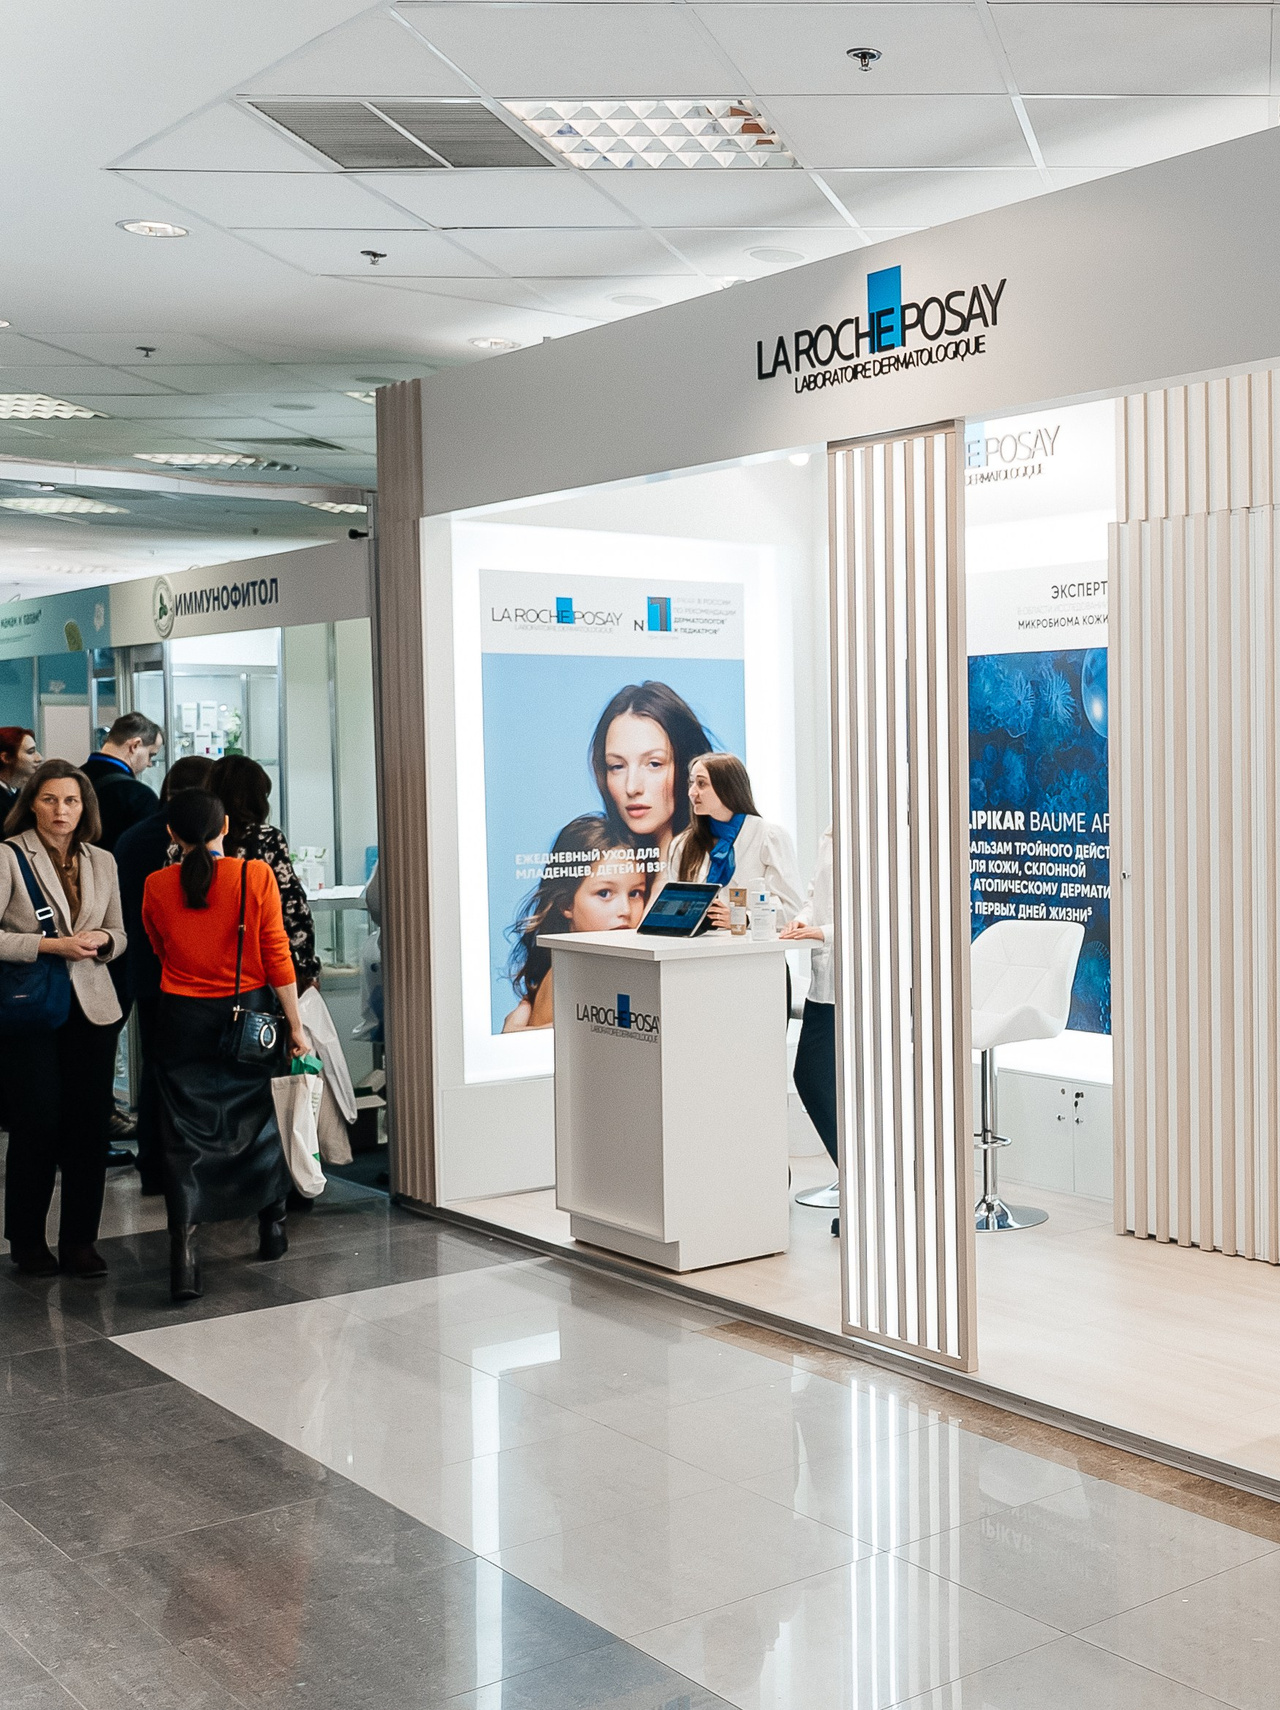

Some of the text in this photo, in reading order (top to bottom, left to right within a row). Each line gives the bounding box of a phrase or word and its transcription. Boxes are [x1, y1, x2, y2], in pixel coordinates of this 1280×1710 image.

[756, 278, 1007, 380] LA ROCHE POSAY
[794, 335, 987, 394] LABORATOIRE DERMATOLOGIQUE
[985, 425, 1060, 467] POSAY
[175, 578, 279, 617] ИММУНОФИТОЛ
[1051, 581, 1108, 599] ЭКСПЕРТ
[491, 607, 622, 626] LA ROCHE POSAY
[1018, 613, 1108, 630] МИКРОБИОМА КОЖИ
[969, 811, 1025, 831] IPIKAR
[1030, 812, 1086, 832] BAUME
[515, 847, 660, 866] ЕЖЕДНЕВНЫЙ УХОД ДЛЯ
[969, 840, 1110, 860] АЛЬЗАМ ТРОЙНОГО ДЕЙСТ
[515, 861, 668, 880] МЛАДЕНЦЕВ, ДЕТЕЙ И ВЗР
[988, 860, 1022, 876] КОЖИ,
[1024, 862, 1086, 878] СКЛОННОЙ
[973, 878, 1059, 895] АТОПИЧЕСКОМУ
[1060, 882, 1110, 900] ДЕРМАТИ
[975, 902, 1016, 917] ПЕРВЫХ
[1018, 903, 1047, 919] ДНЕЙ
[576, 1003, 659, 1034] LA ROCHE POSA
